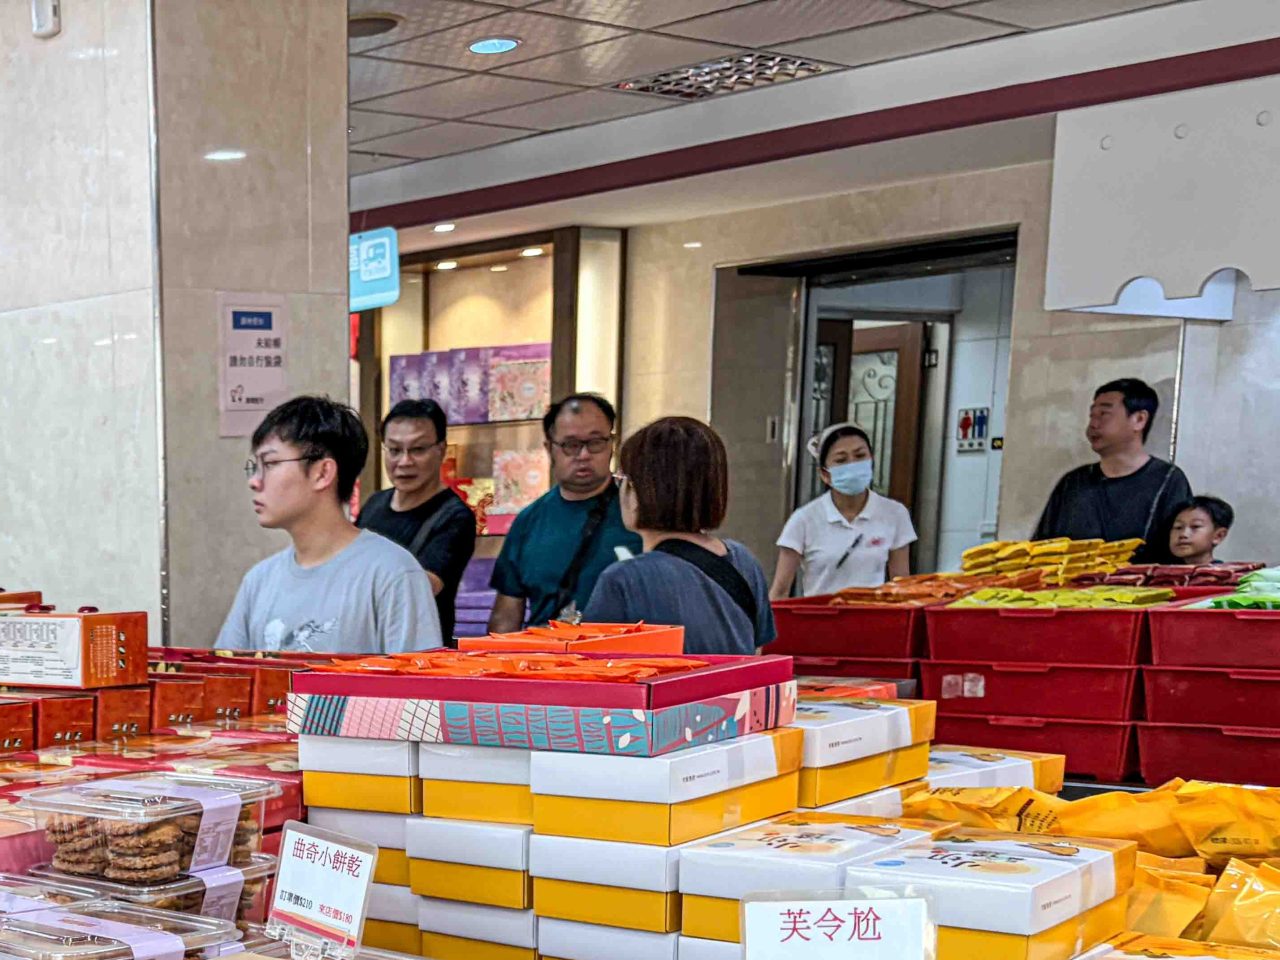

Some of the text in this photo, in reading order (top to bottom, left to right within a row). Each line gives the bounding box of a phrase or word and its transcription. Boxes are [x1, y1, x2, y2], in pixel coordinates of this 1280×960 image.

[292, 838, 362, 878] 曲奇小餅乾
[280, 889, 353, 925] 訂單價$210 來店價$180
[779, 906, 882, 943] 芙令尬
